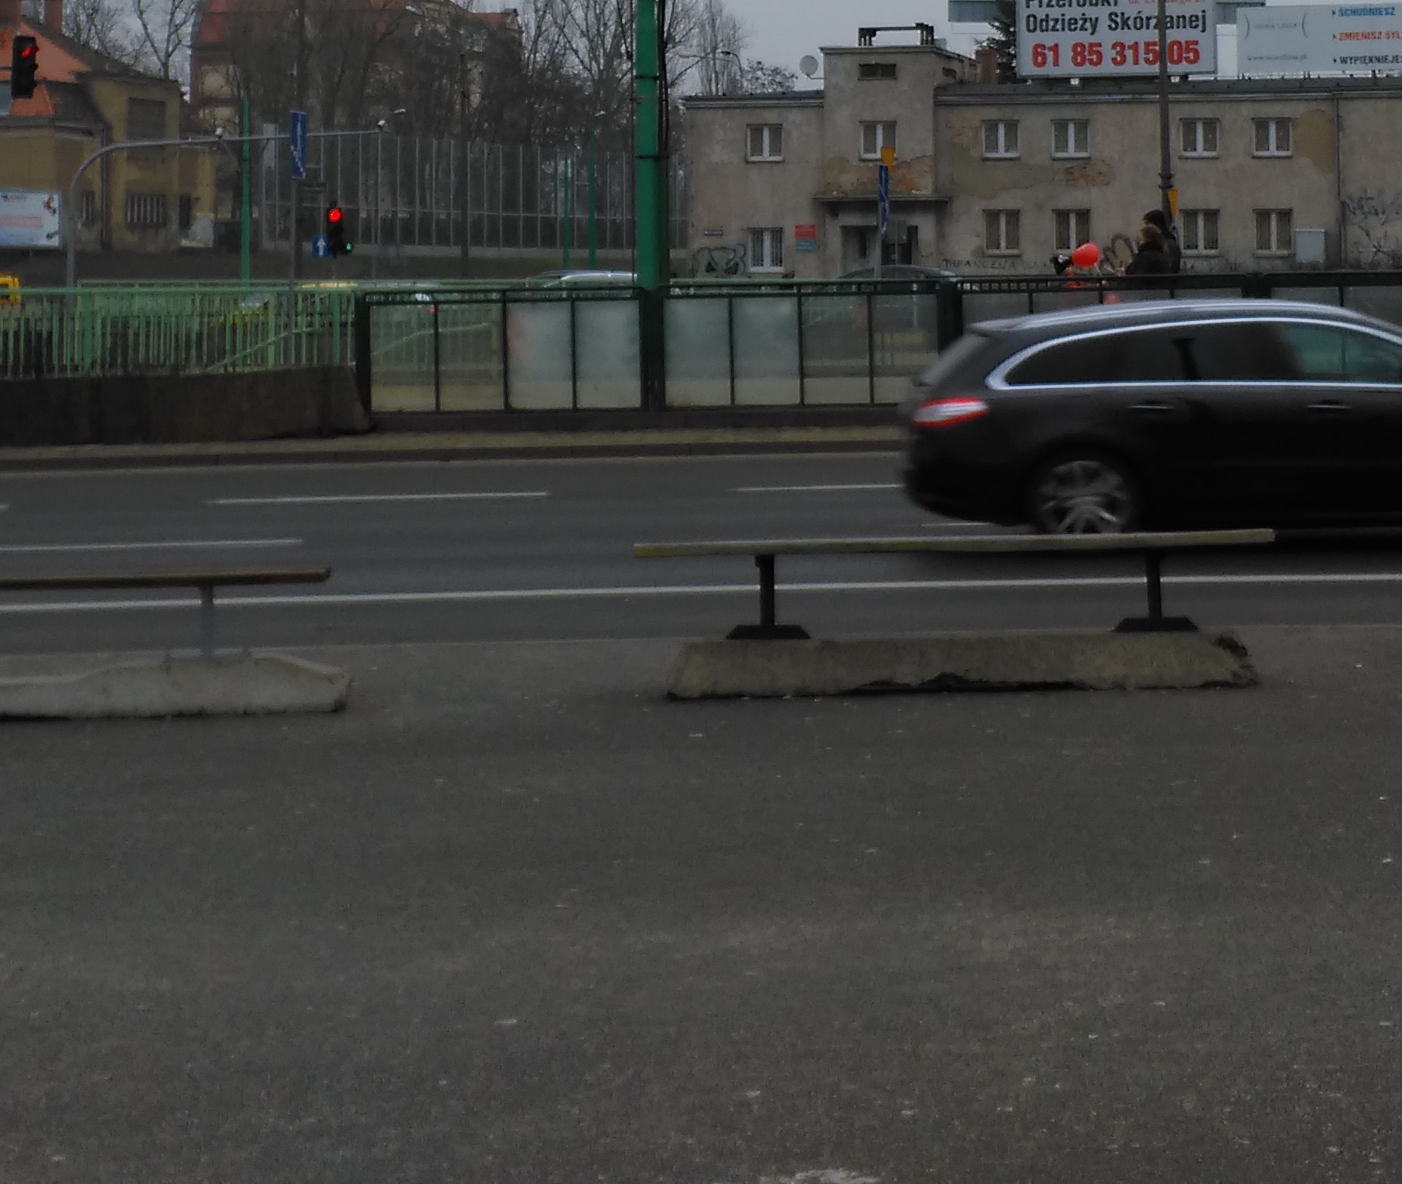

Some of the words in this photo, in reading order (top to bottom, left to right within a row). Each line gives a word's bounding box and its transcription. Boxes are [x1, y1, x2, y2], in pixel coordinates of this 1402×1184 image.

[1025, 13, 1099, 35] Odzieży
[1032, 43, 1060, 68] 61
[1071, 41, 1103, 67] 85
[1167, 39, 1200, 65] 05
